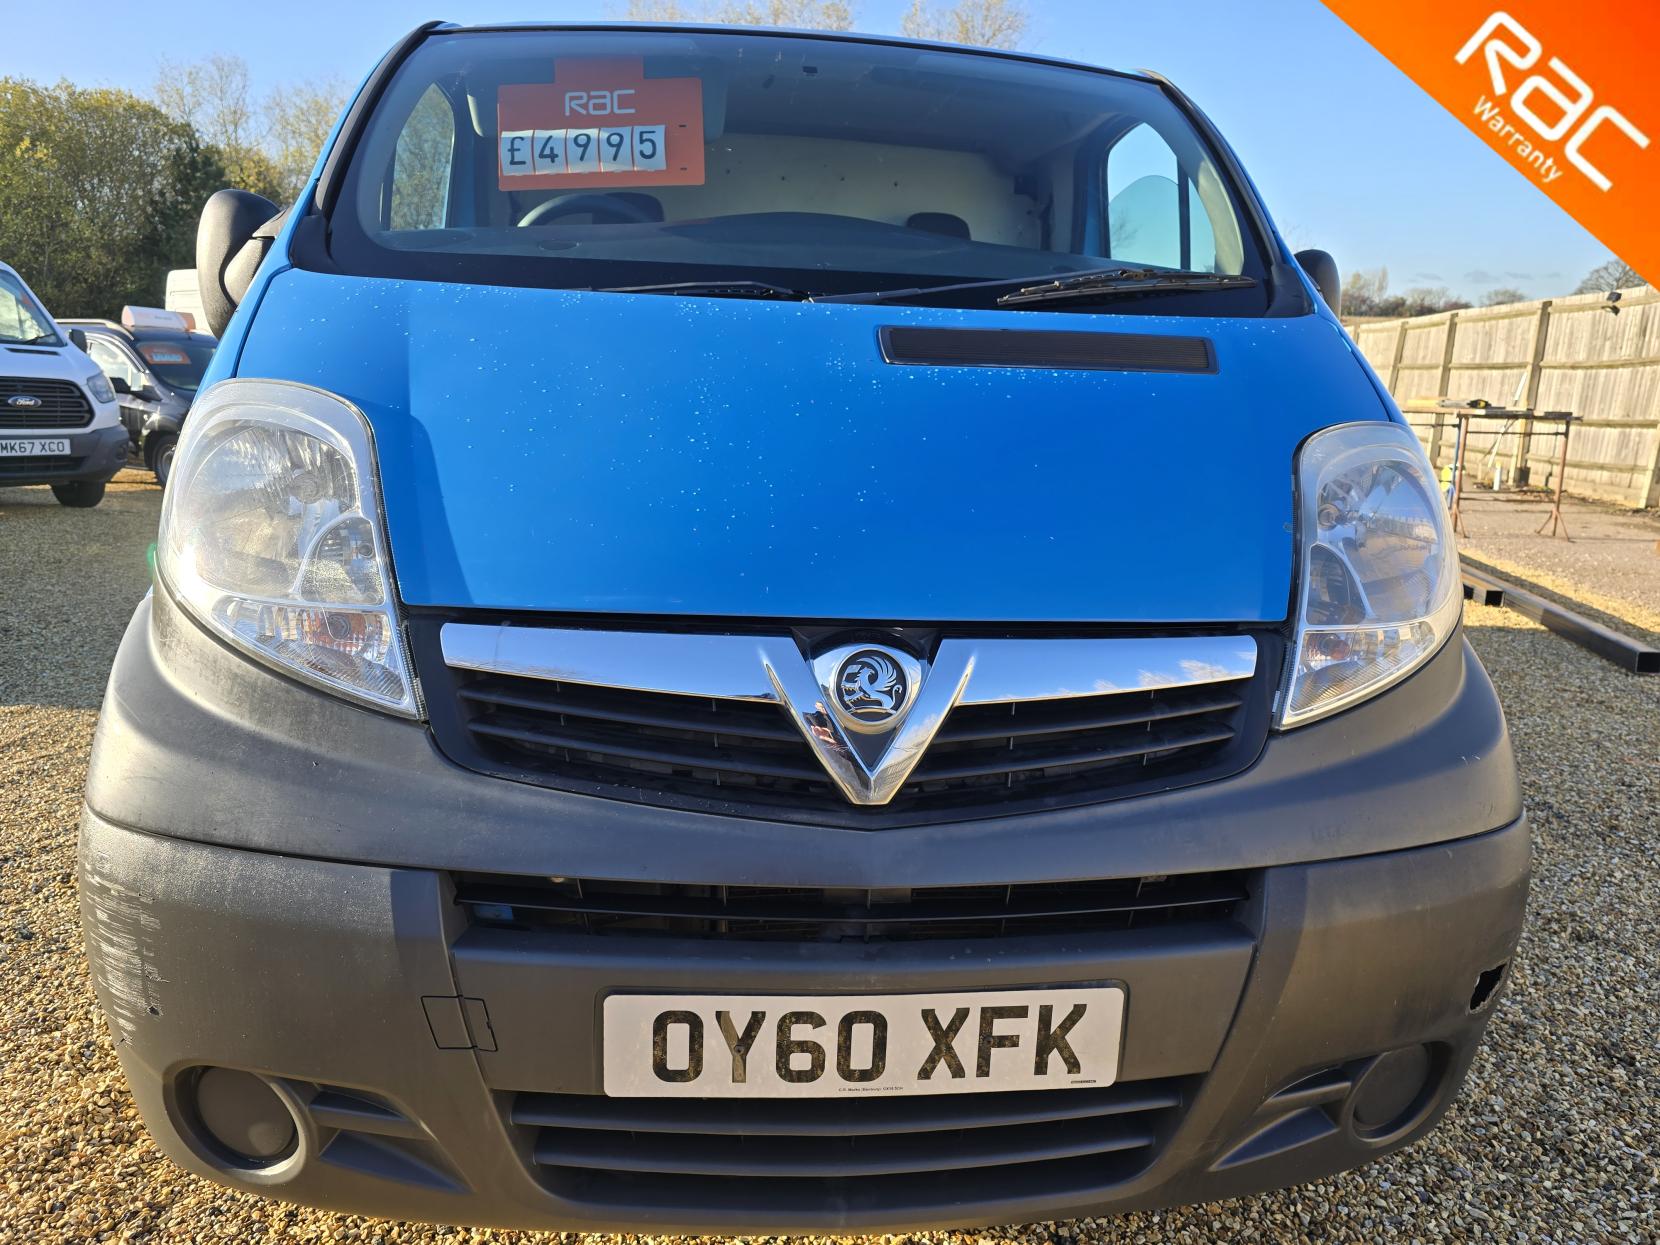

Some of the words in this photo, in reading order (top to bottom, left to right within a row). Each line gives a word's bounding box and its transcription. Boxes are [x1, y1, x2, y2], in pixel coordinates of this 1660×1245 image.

[507, 130, 657, 166] £4995
[0, 441, 35, 454] MK67
[39, 441, 65, 453] XCO
[652, 1009, 889, 1084] OY60
[916, 1003, 1088, 1081] XFK
